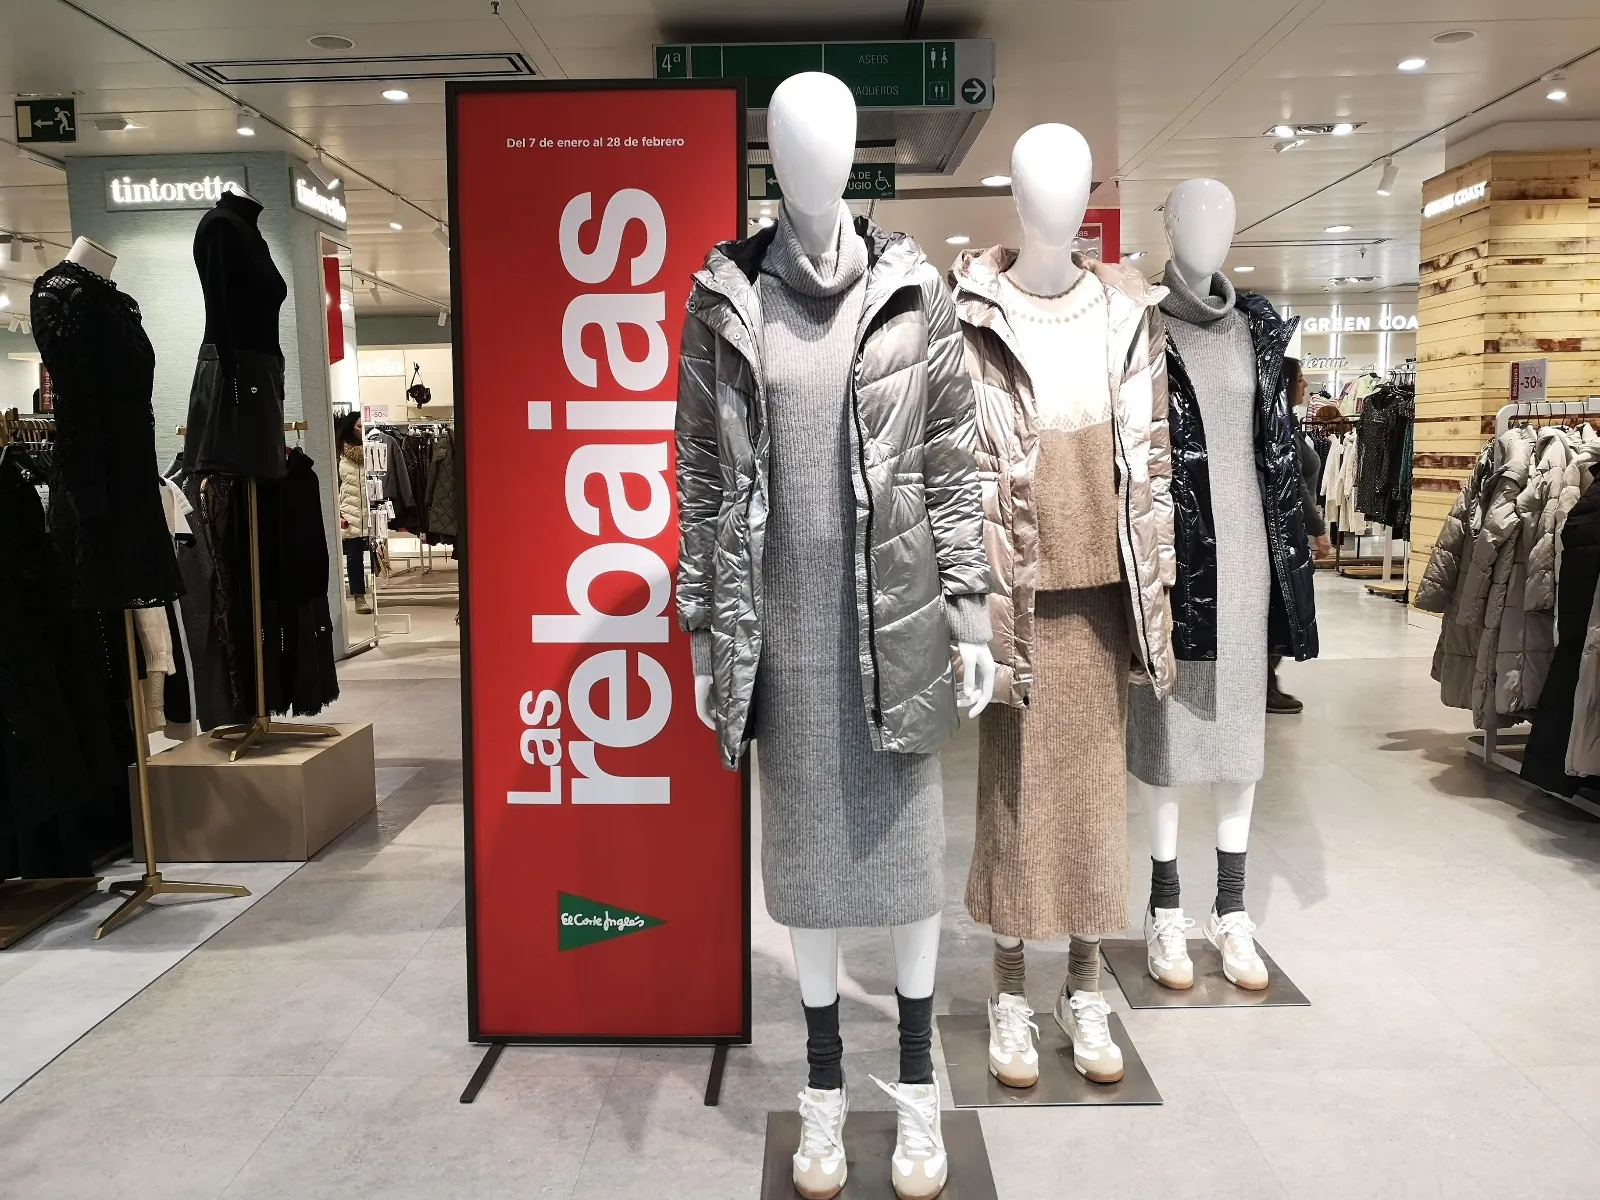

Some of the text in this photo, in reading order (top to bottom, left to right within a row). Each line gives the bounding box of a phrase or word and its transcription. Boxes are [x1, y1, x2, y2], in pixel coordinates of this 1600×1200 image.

[858, 54, 889, 64] ASEOS
[506, 136, 685, 148] Del 7 de enero al 28 de febrero
[858, 171, 871, 180] DE
[847, 181, 872, 190] UGIO
[1303, 315, 1419, 332] GREEN COA
[1520, 375, 1543, 389] -30%
[506, 689, 562, 805] Las
[560, 910, 646, 932] El Corte Inglés
